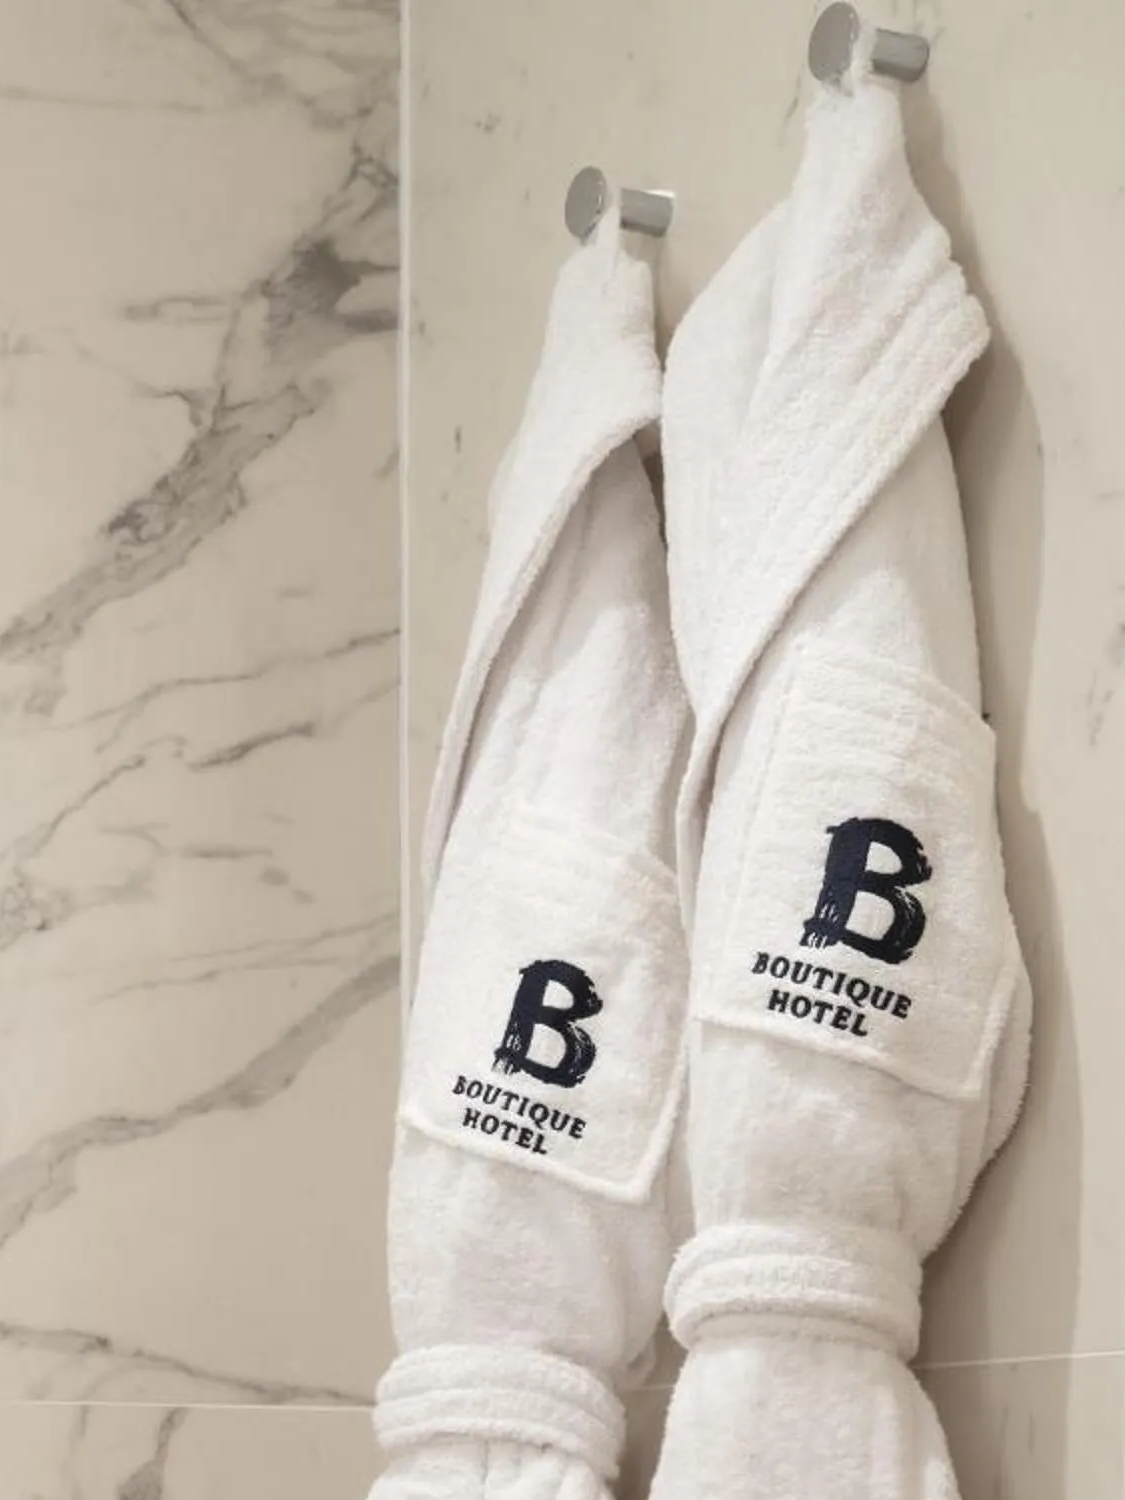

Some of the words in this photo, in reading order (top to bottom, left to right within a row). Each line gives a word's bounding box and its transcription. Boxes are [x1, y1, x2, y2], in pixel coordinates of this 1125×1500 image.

[799, 817, 932, 964] B
[751, 952, 913, 1019] BOUTIQUE
[767, 989, 868, 1037] HOTEL
[491, 959, 604, 1089] B
[452, 1075, 587, 1139] BOUTIQUE
[462, 1107, 549, 1155] HOTEL
